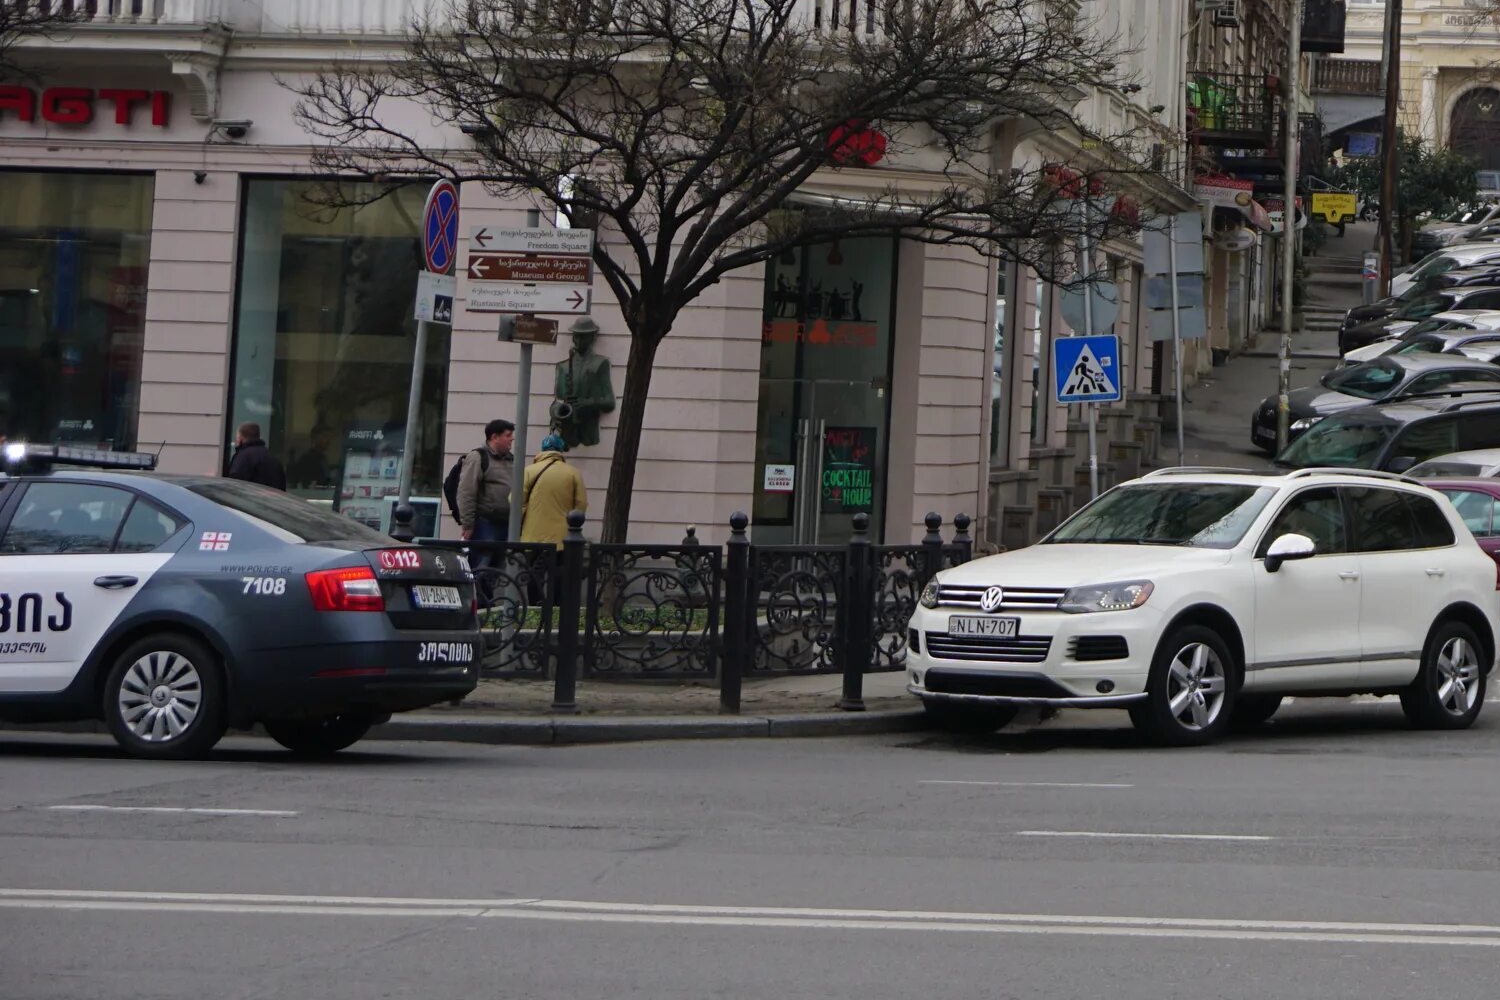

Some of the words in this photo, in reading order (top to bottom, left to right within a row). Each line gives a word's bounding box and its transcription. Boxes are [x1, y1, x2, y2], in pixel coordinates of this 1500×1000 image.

[527, 241, 559, 249] Freedom
[561, 242, 588, 250] Square
[511, 271, 545, 279] Museum
[546, 271, 555, 279] of
[556, 272, 585, 281] Georgia
[470, 300, 506, 308] Rustaveli
[508, 300, 535, 309] Square
[823, 469, 872, 487] COCKTAIL
[842, 488, 872, 505] HOUR
[395, 550, 420, 567] 112
[220, 565, 294, 574] WWW.POLICE.GE
[242, 576, 287, 595] 7108
[958, 619, 1015, 634] NLN-707
[0, 642, 47, 654] ველოს
[419, 642, 473, 662] პოლიცია
